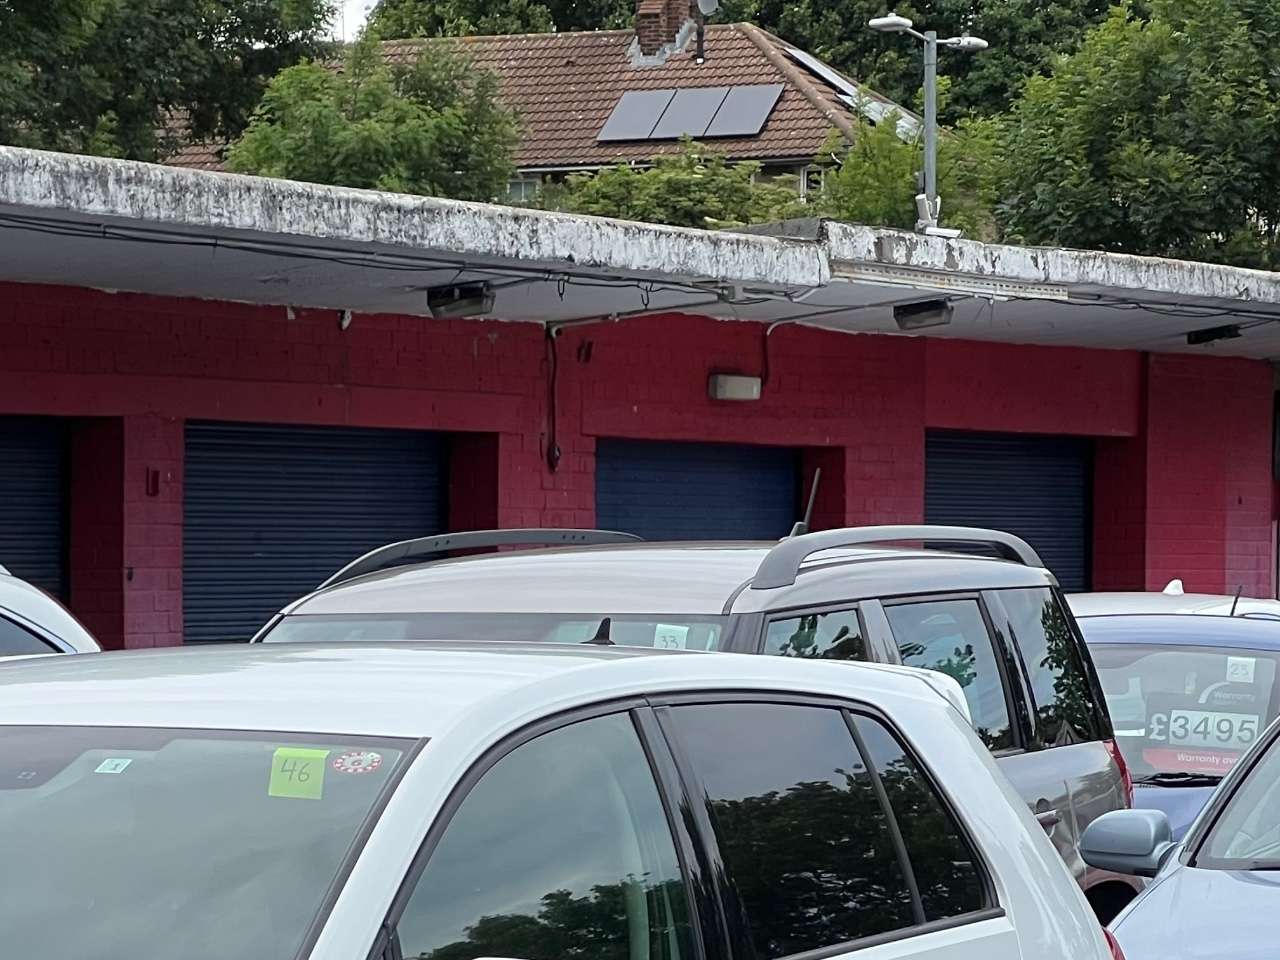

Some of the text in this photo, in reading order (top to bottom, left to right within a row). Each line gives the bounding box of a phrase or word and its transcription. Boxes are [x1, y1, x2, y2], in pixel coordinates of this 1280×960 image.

[1148, 713, 1256, 743] £3495
[280, 758, 311, 782] 46
[1177, 752, 1220, 765] Warranty
